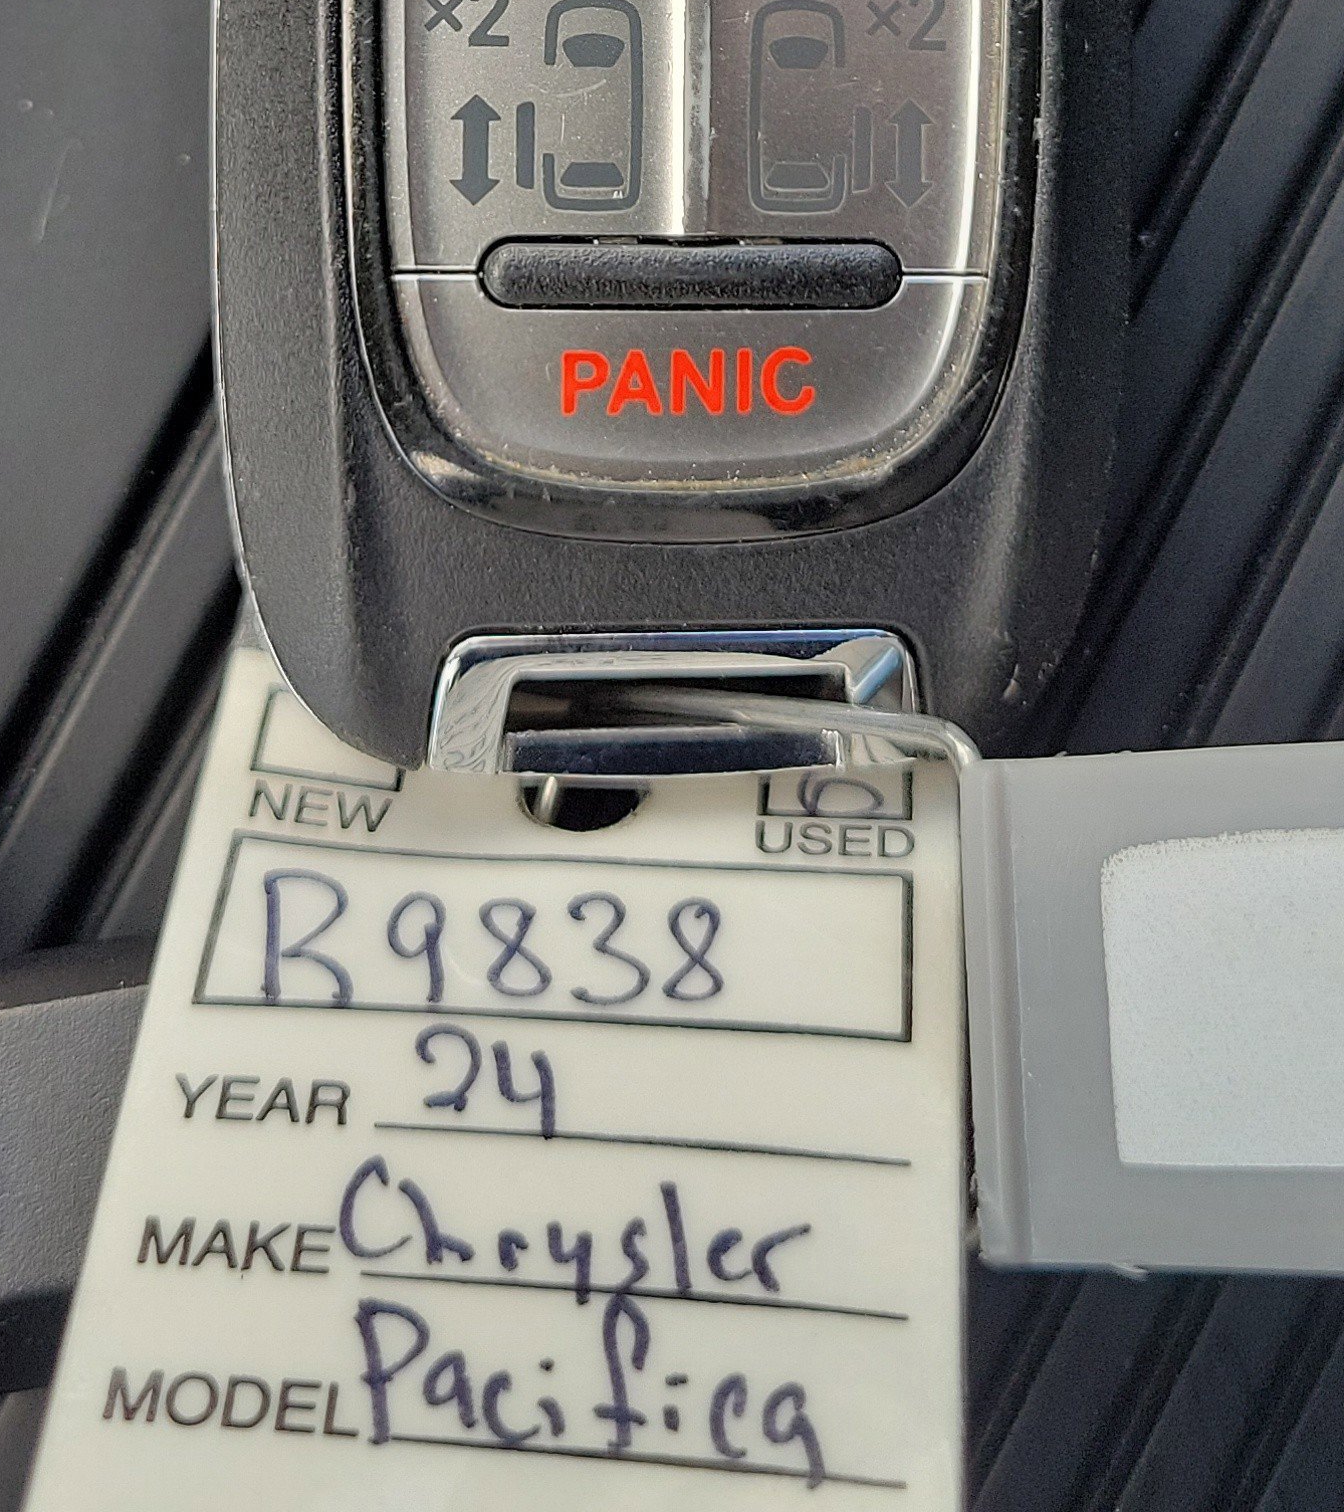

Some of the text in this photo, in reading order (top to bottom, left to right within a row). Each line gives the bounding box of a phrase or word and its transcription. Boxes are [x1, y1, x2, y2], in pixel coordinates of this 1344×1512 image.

[561, 346, 816, 416] PANIC
[249, 779, 393, 833] NEW
[754, 819, 916, 859] USED
[261, 867, 725, 1007] R9838
[175, 1073, 352, 1126] YEAR
[414, 1022, 556, 1140] 24
[136, 1216, 337, 1276] MAKE
[338, 1155, 812, 1305] Chrysler
[102, 1366, 359, 1440] MODEL
[354, 1294, 825, 1490] Pacifica
